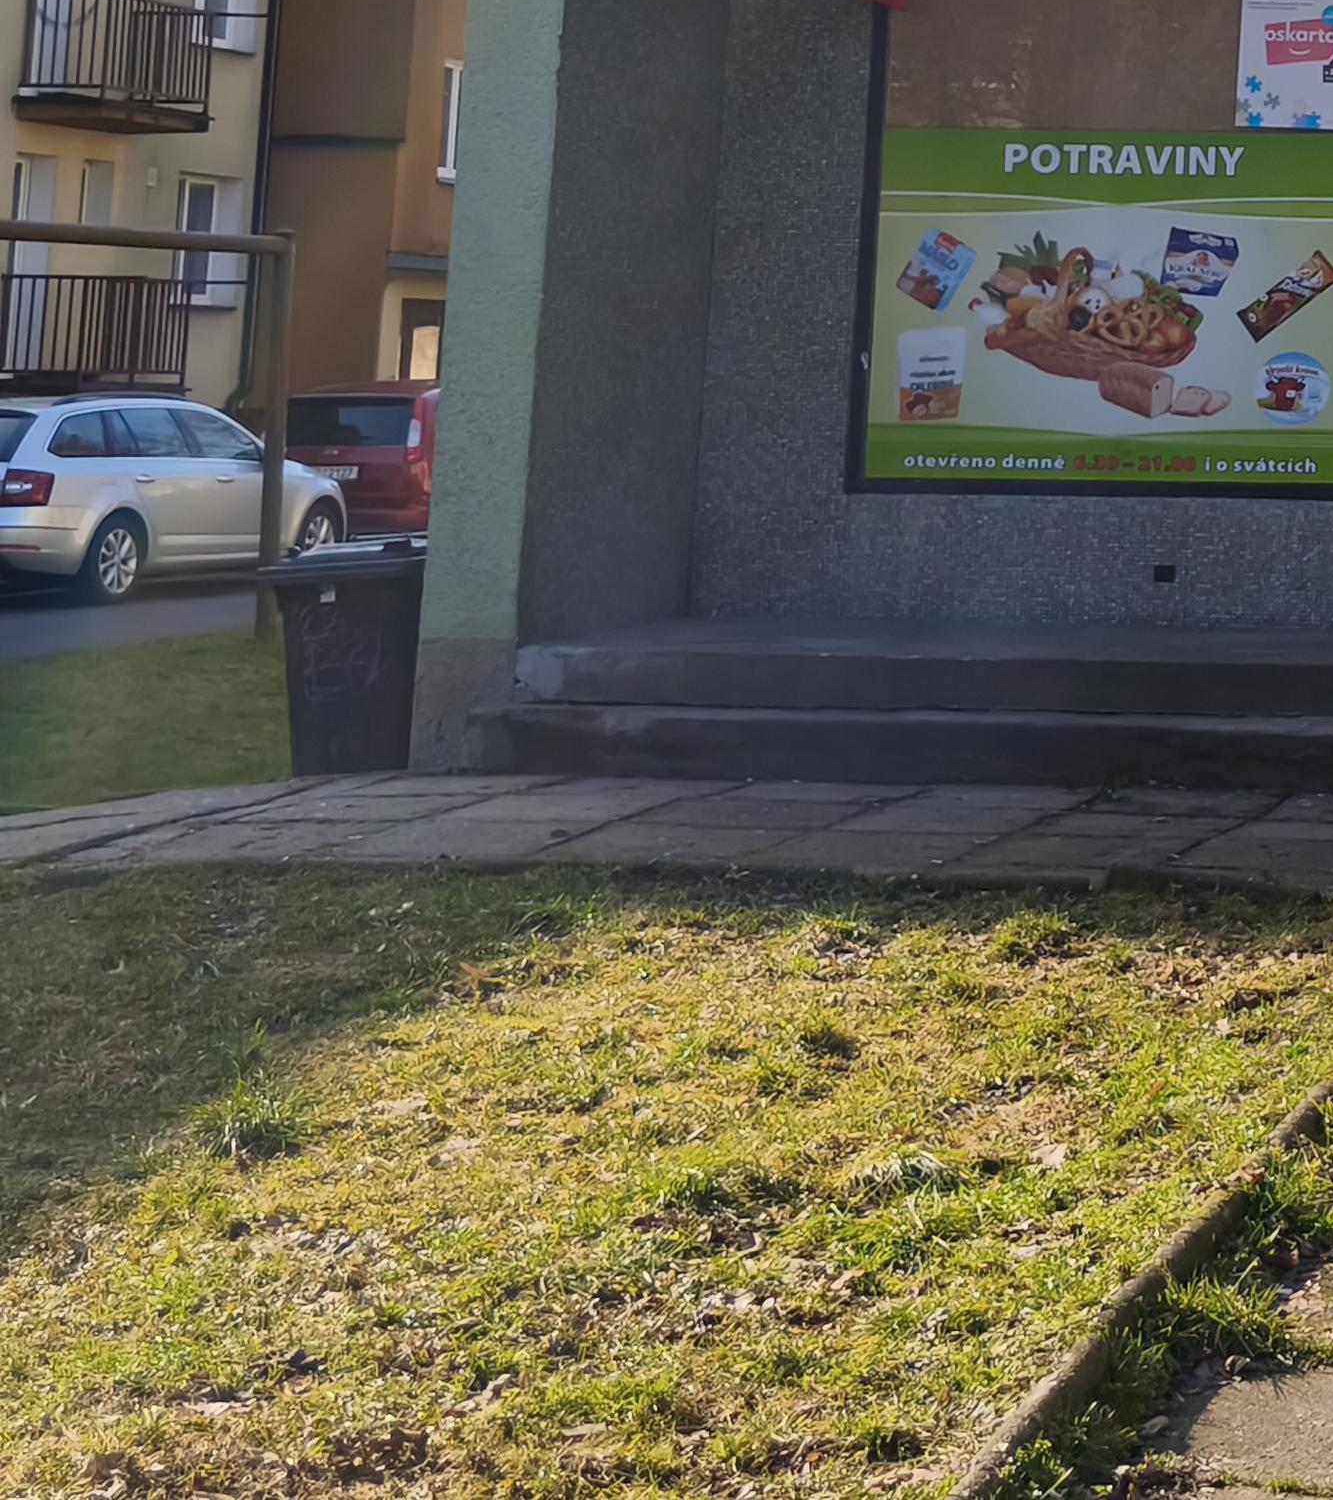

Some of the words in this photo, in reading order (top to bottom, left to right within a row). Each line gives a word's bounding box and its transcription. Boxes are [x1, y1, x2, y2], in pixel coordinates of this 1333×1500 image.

[1003, 143, 1245, 176] POTRAVINY
[903, 453, 997, 469] otevřeno
[1002, 453, 1066, 470] denně
[1215, 459, 1228, 473] o
[1233, 455, 1318, 475] svátcích
